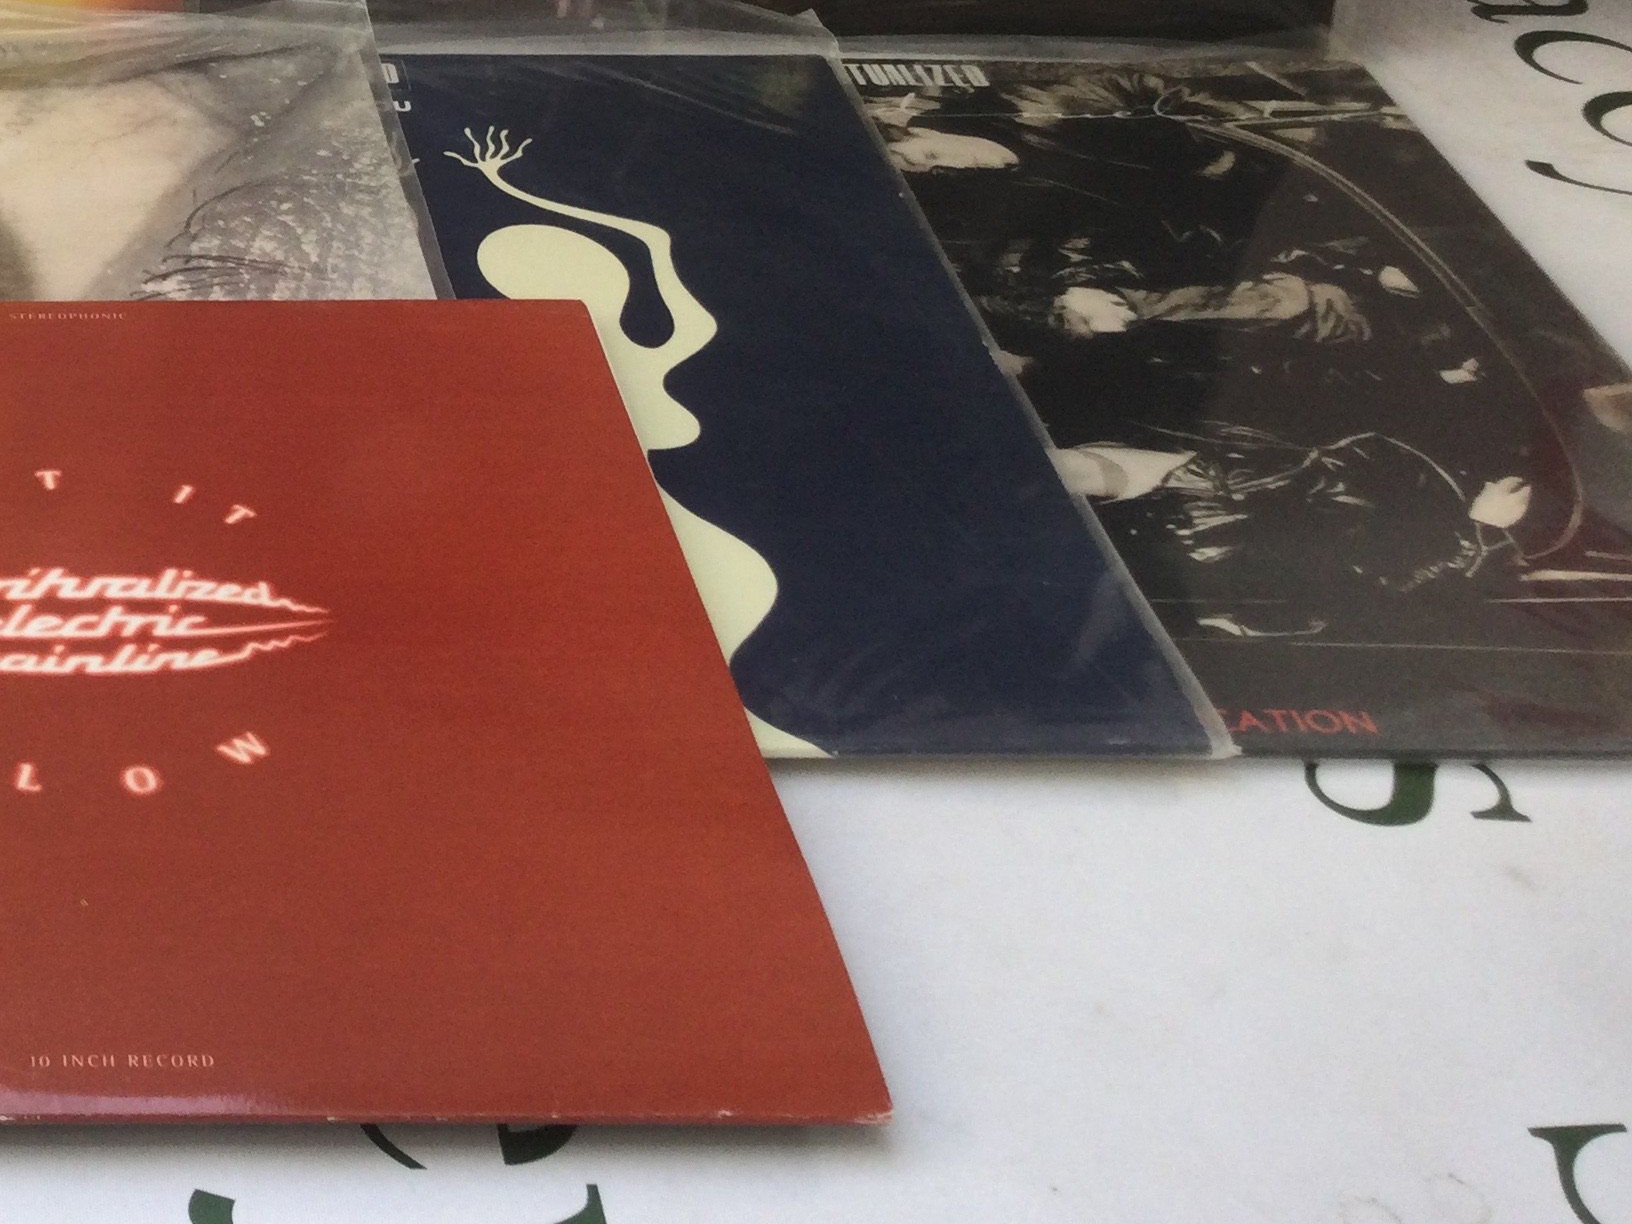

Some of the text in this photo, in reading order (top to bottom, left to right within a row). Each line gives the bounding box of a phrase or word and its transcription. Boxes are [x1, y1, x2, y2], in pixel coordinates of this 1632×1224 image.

[173, 483, 257, 525] IT
[29, 1054, 216, 1069] 10 INCH RECORD
